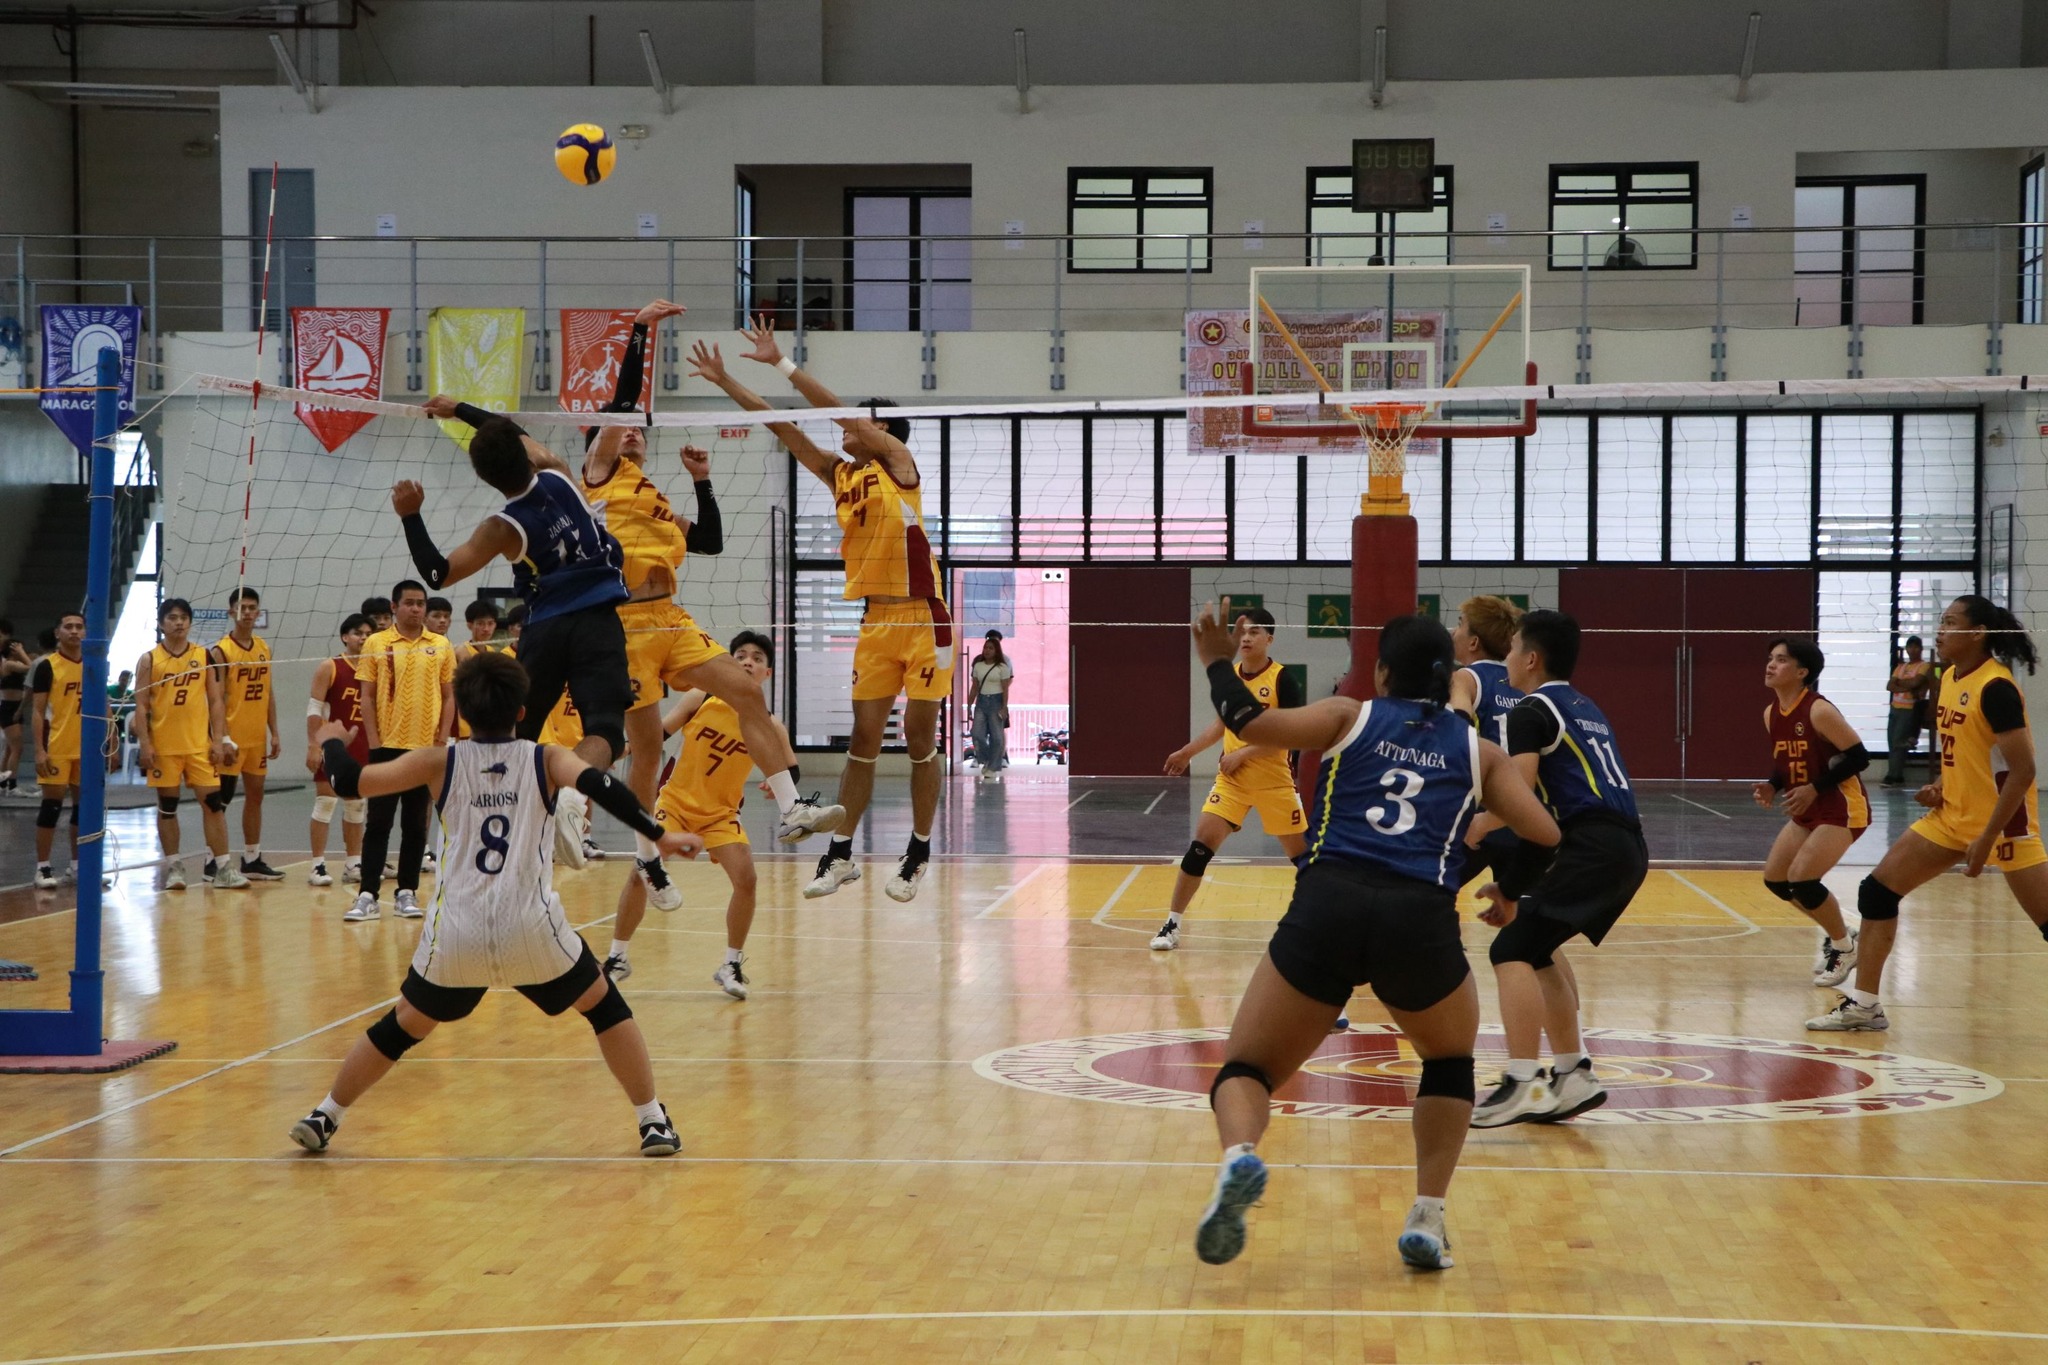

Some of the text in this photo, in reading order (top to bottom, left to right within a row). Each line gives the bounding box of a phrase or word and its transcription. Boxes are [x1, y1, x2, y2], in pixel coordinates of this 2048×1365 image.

[1213, 361, 1420, 379] OVALL CHMPON
[41, 399, 135, 411] MARAGOON
[571, 399, 646, 412] BATN
[720, 428, 751, 438] EXIT
[193, 610, 228, 618] NOTICE
[161, 672, 200, 687] PUP
[236, 666, 268, 683] PUP
[920, 666, 936, 688] 4
[173, 689, 188, 706] 8
[244, 684, 264, 701] 22
[341, 687, 362, 702] PU
[696, 726, 749, 757] PUP
[1773, 740, 1808, 759] PUP
[1374, 740, 1447, 769] ATTUNAGA
[1587, 736, 1629, 790] 11
[705, 753, 723, 776] 7
[1788, 761, 1808, 784] 15
[1366, 767, 1425, 835] 3
[1291, 809, 1301, 825] 9
[729, 820, 741, 835] 7
[475, 814, 510, 875] 8
